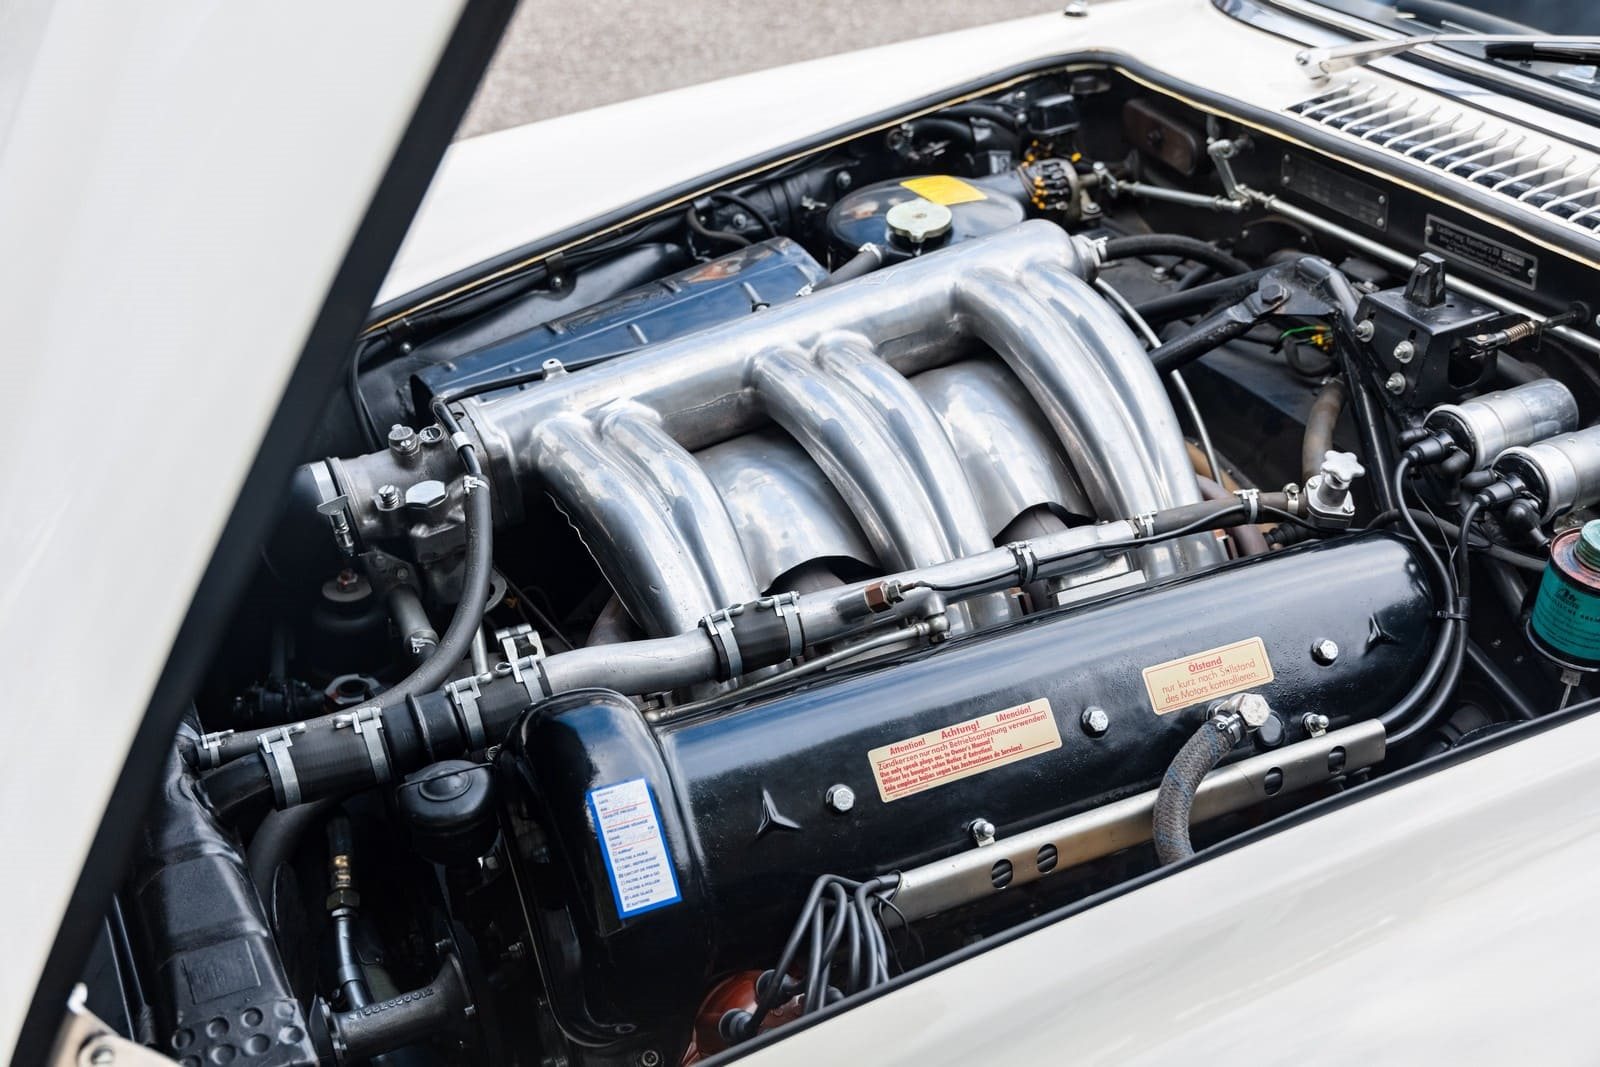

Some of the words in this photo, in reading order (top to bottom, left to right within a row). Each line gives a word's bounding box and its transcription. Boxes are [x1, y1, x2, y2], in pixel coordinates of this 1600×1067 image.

[1188, 656, 1222, 672] Ölstand
[1162, 684, 1175, 694] nur
[1177, 679, 1196, 689] kurz
[1198, 670, 1218, 683] nach
[1219, 658, 1256, 677] Stillstand
[1165, 694, 1179, 704] des
[1180, 686, 1208, 699] Motors
[877, 754, 918, 771] Zündkerzen
[919, 750, 930, 758] nur
[931, 744, 948, 754] nach
[949, 726, 1008, 748] Betriebsanleitung
[1008, 712, 1047, 730] verwenden!
[890, 738, 926, 755] Attention!
[941, 720, 980, 742] Achtung!
[882, 775, 901, 785] Utiliser
[891, 767, 902, 775] only
